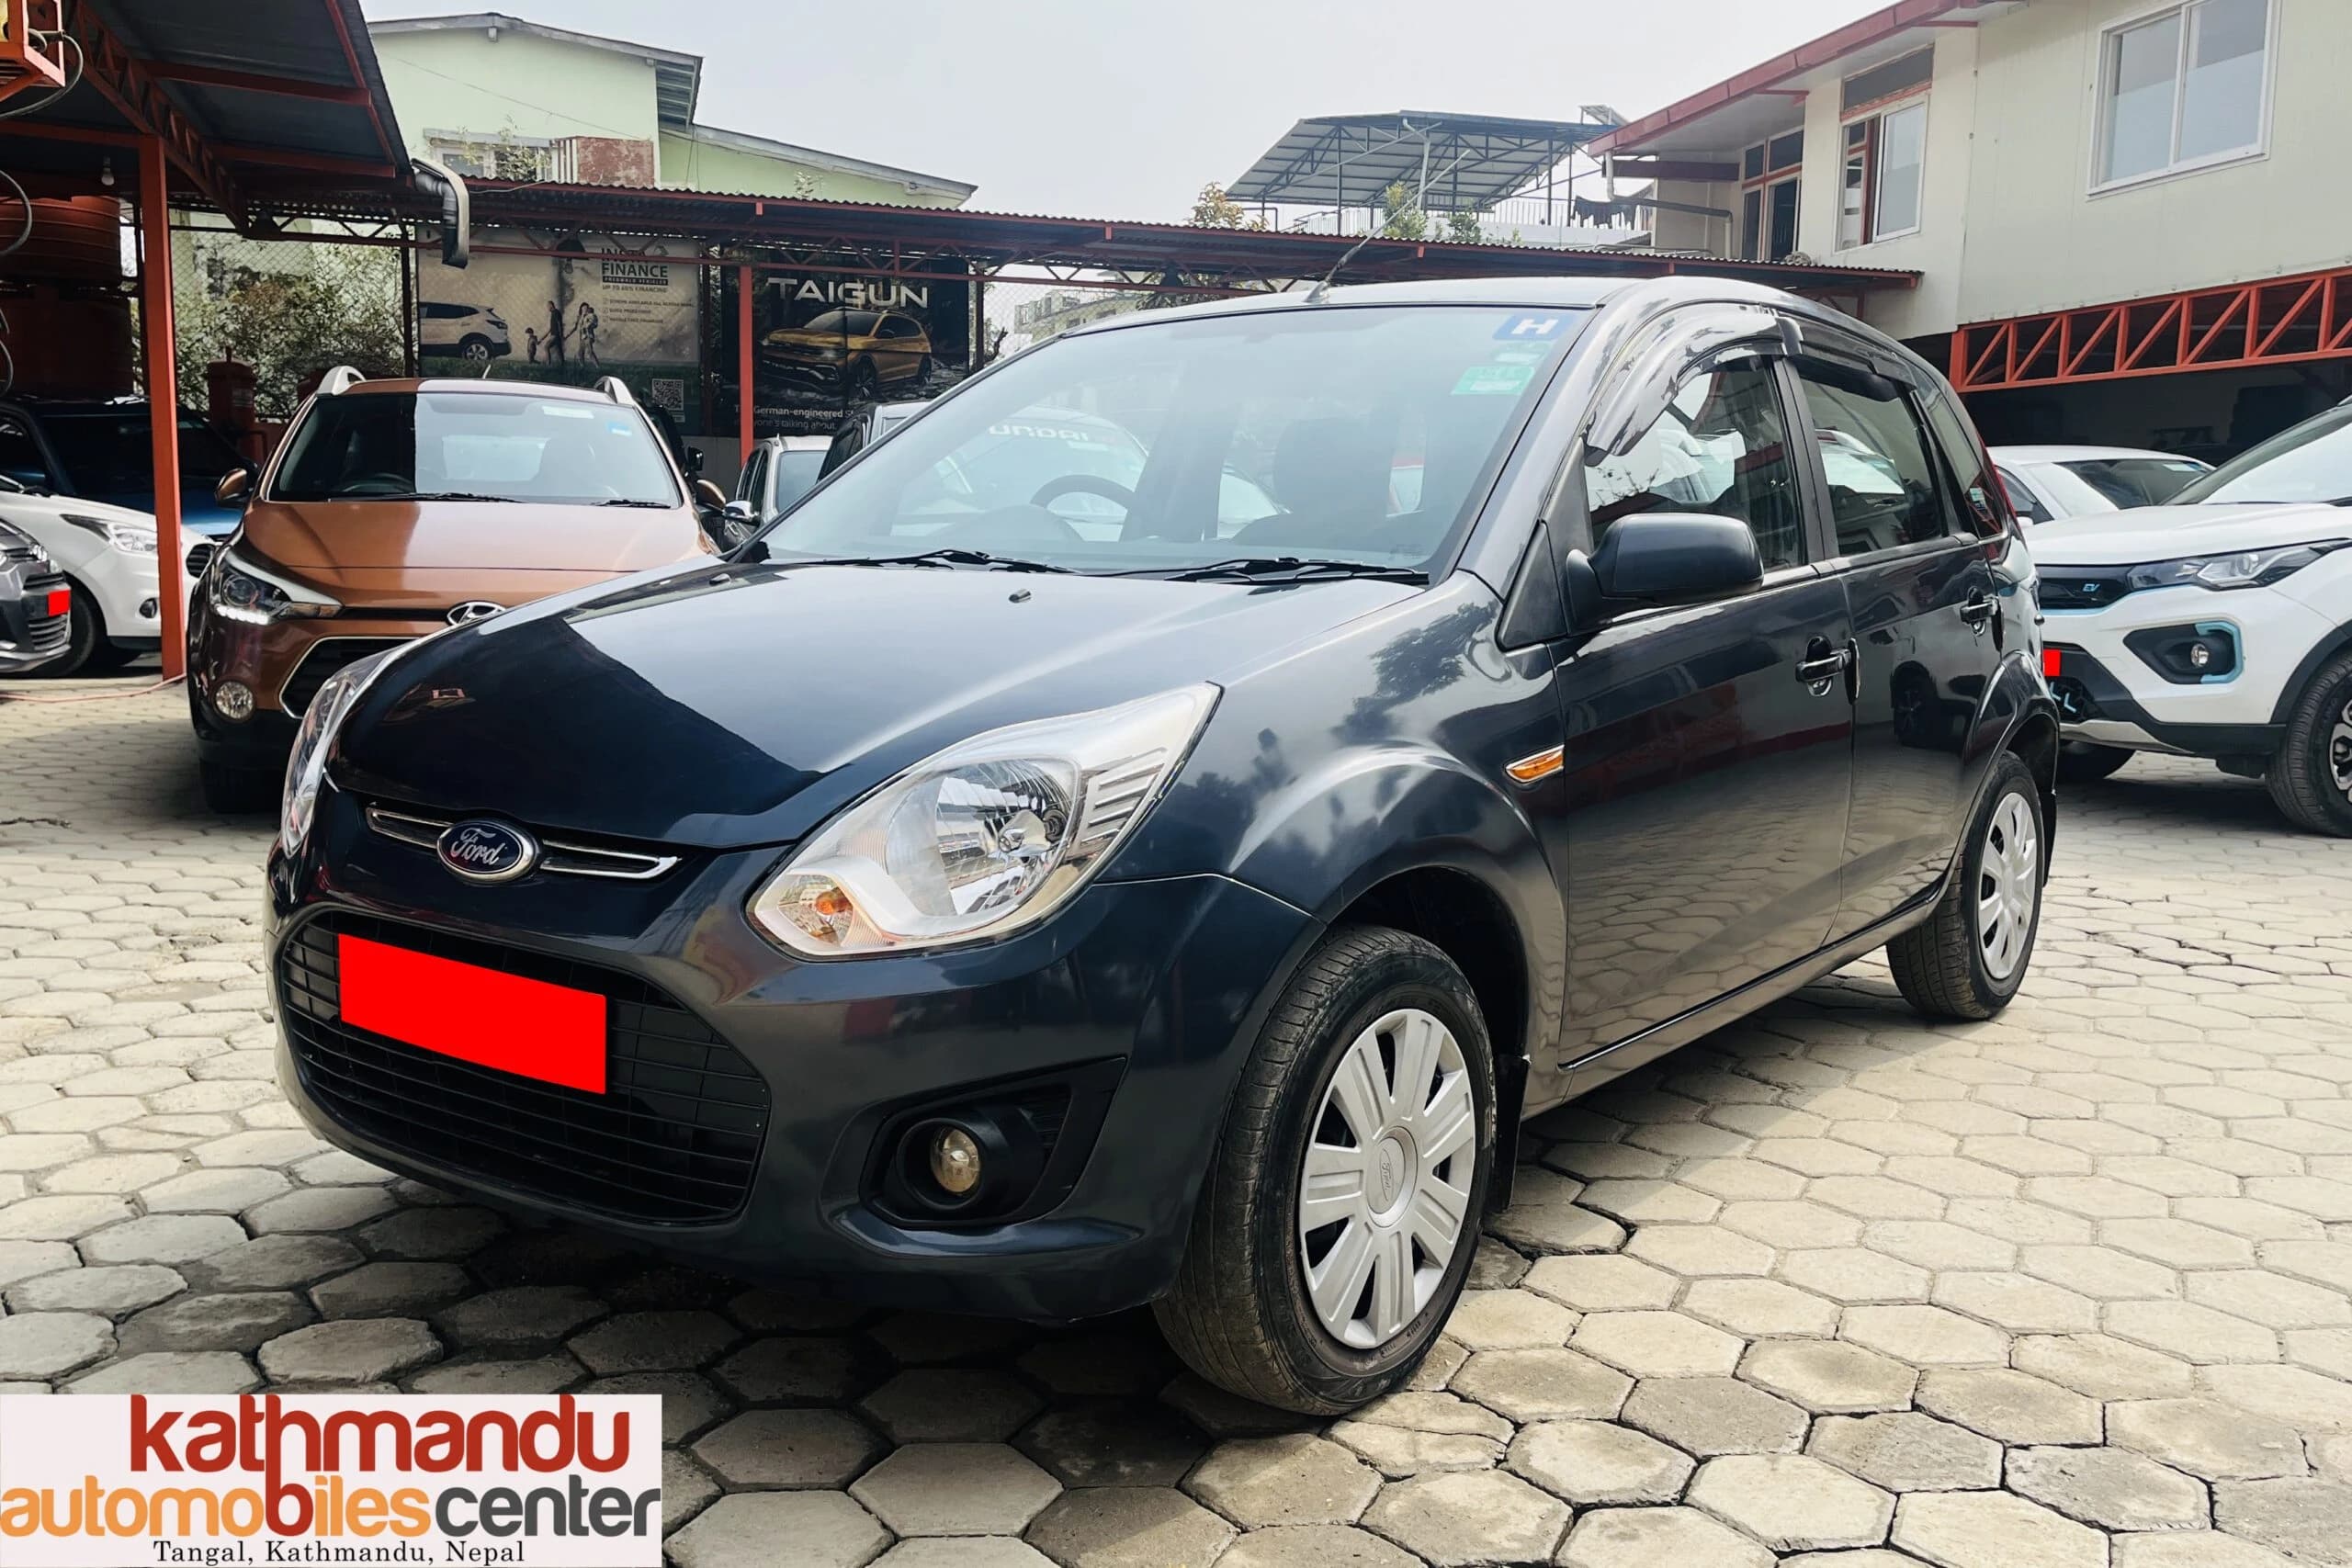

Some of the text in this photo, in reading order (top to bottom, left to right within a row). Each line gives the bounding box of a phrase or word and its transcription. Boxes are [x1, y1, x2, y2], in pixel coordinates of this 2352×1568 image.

[602, 262, 668, 277] FINANCE
[766, 277, 928, 309] TAIGUN
[1511, 318, 1559, 334] H
[753, 405, 843, 419] German-engineered
[781, 420, 808, 429] talking
[2082, 583, 2101, 592] EV
[450, 827, 507, 865] Ford
